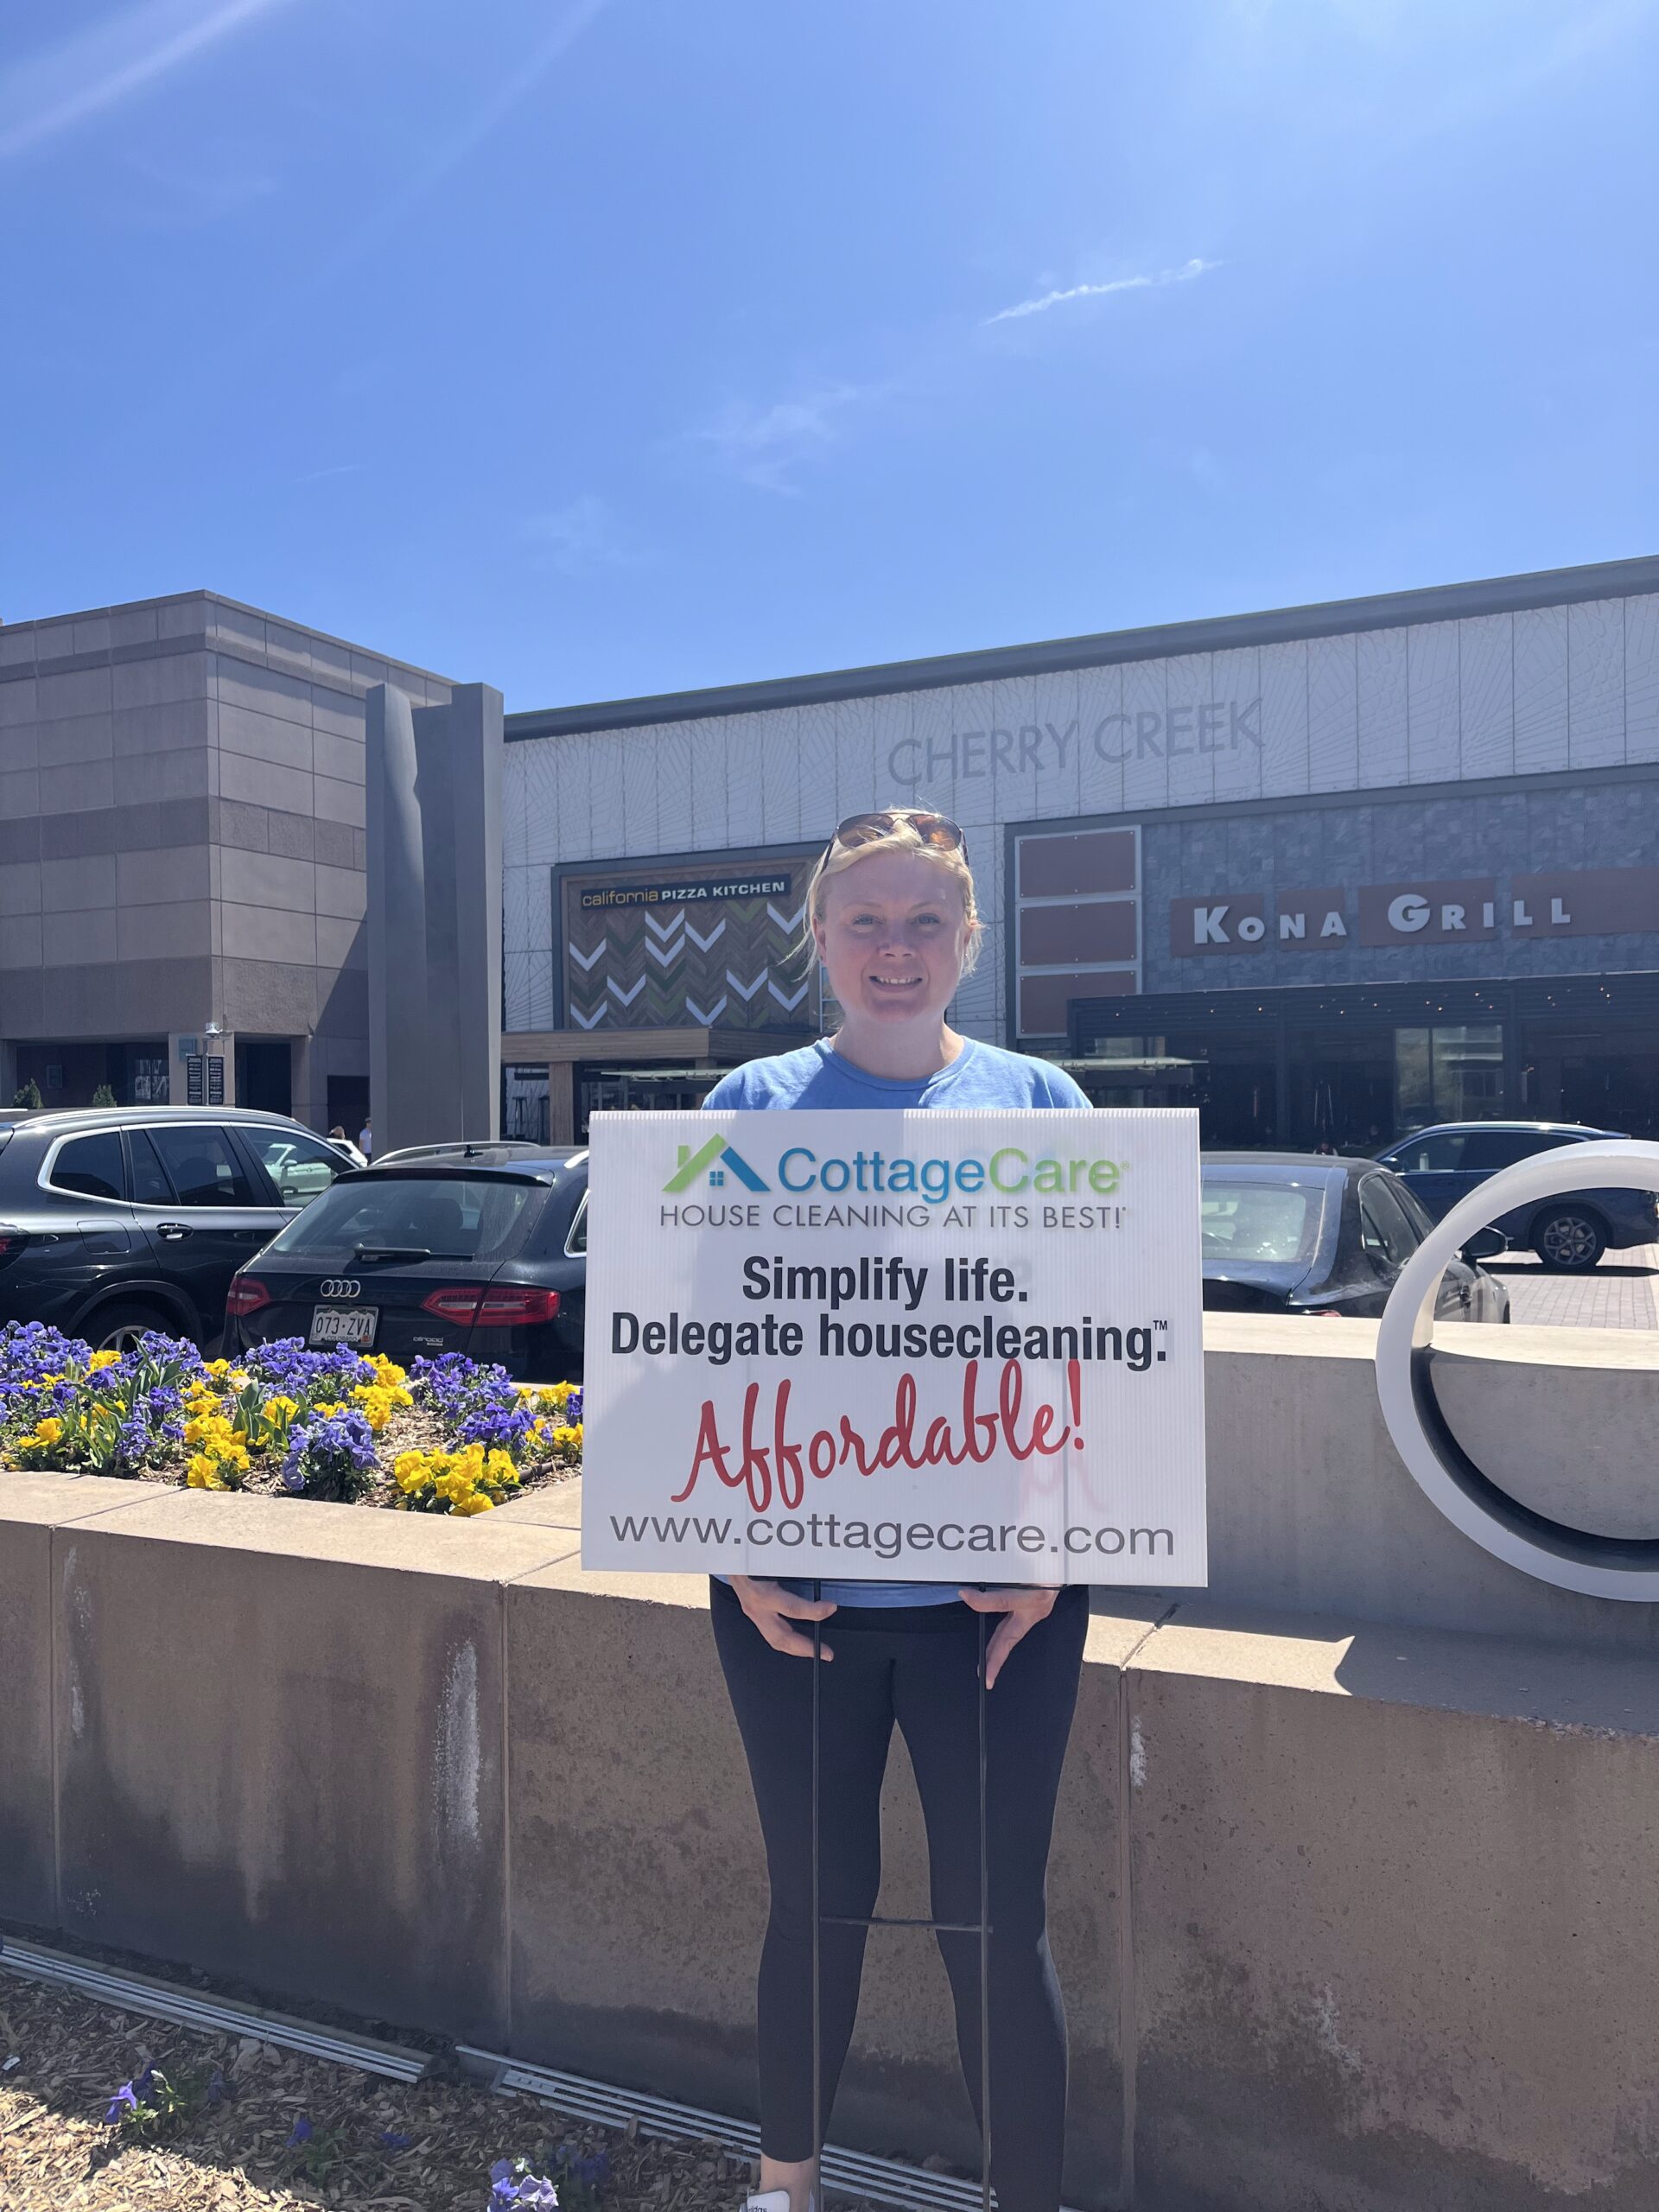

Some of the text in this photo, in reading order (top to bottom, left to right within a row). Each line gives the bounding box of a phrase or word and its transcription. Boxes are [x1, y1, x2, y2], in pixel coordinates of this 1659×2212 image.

[887, 697, 1266, 785] CHERRY CREEK
[582, 881, 785, 906] california PIZZA KITCHEN
[1193, 893, 1572, 944] KONA GRILL
[660, 1205, 760, 1227] HOUSE
[772, 1205, 931, 1228] CLEANING
[943, 1205, 977, 1228] AT
[990, 1206, 1029, 1229] ITS
[741, 1255, 1028, 1311] Simplify life.
[612, 1312, 804, 1365] Delegate
[671, 1358, 1084, 1512] Affordable!
[610, 1513, 1174, 1559] www.cottagecare.com
